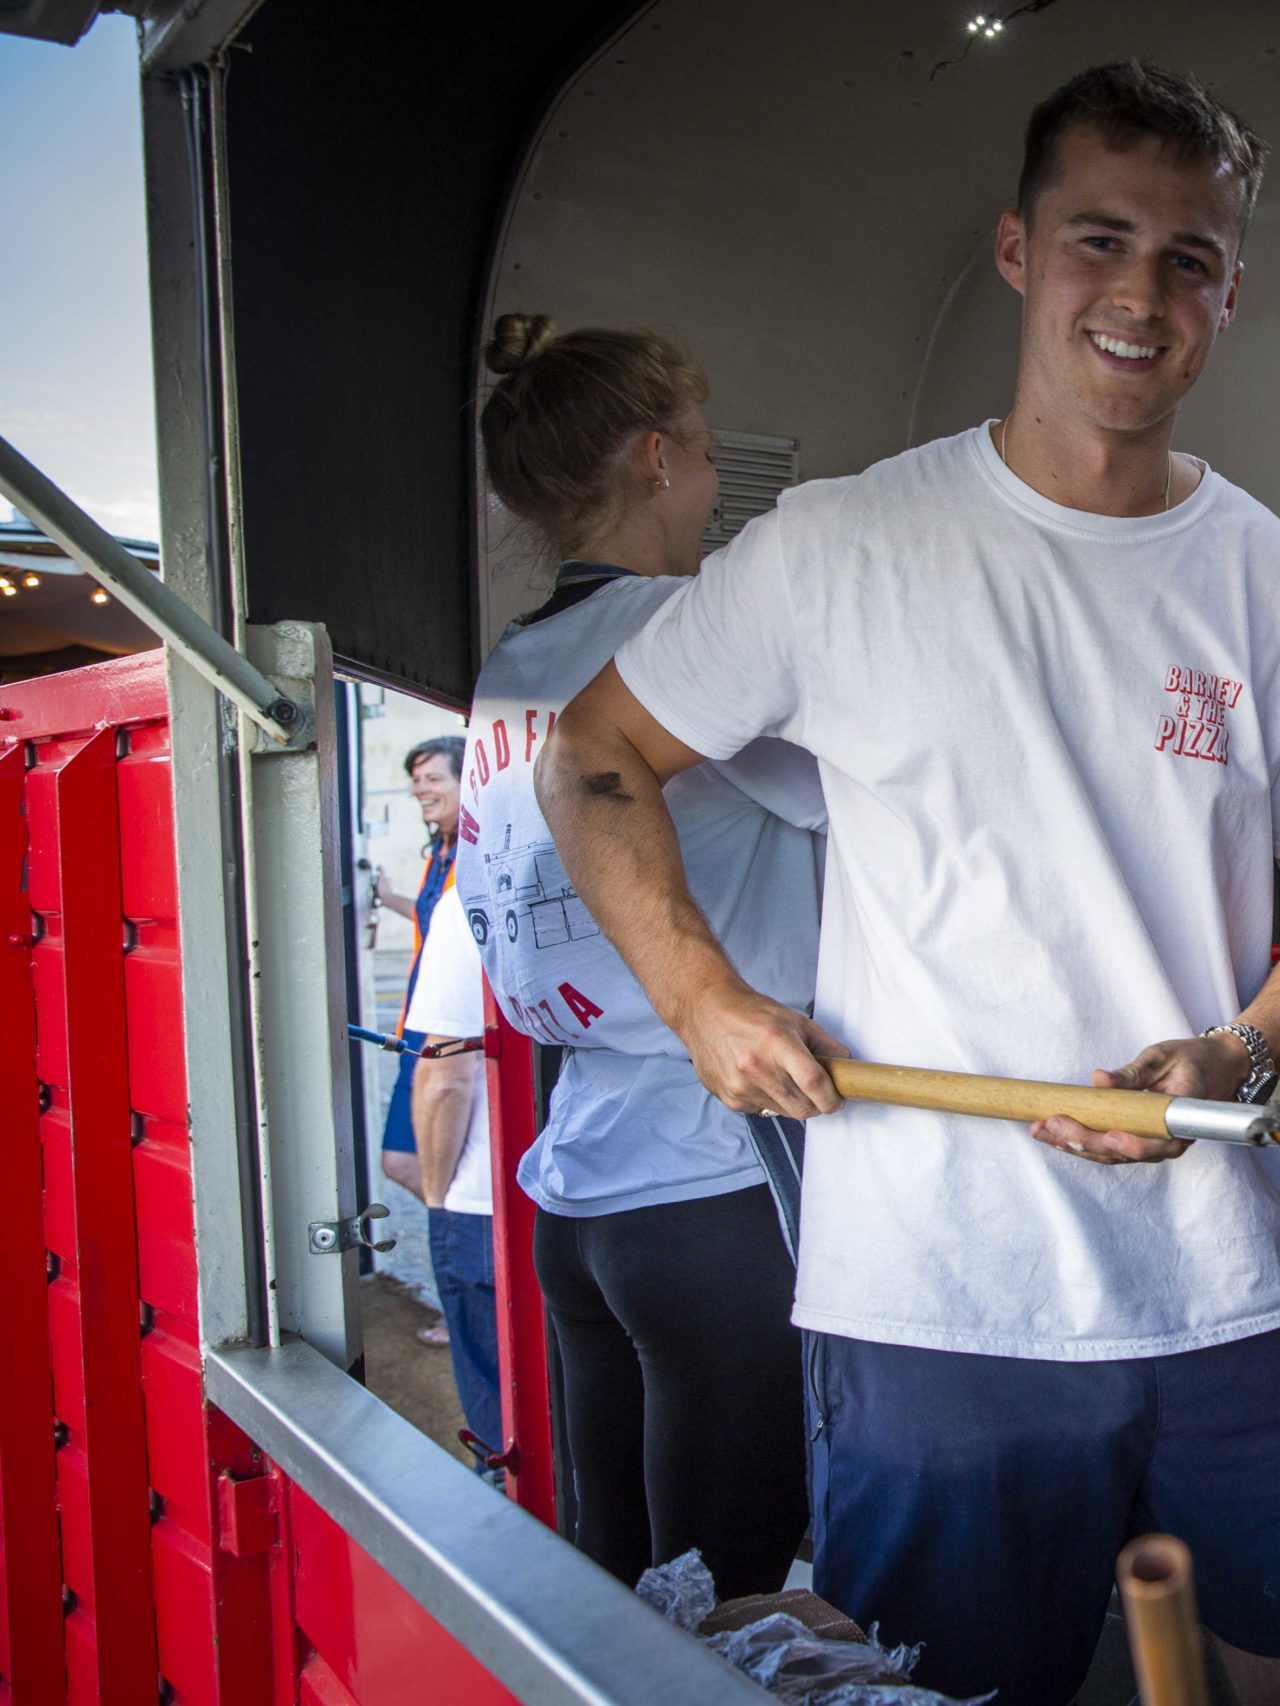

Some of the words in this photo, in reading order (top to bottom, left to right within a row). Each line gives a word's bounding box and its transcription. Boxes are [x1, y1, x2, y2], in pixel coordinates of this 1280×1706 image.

[1164, 664, 1243, 709] BARNEY
[1175, 694, 1190, 718] &
[1197, 697, 1226, 727] THE
[1154, 715, 1229, 766] PIZZA
